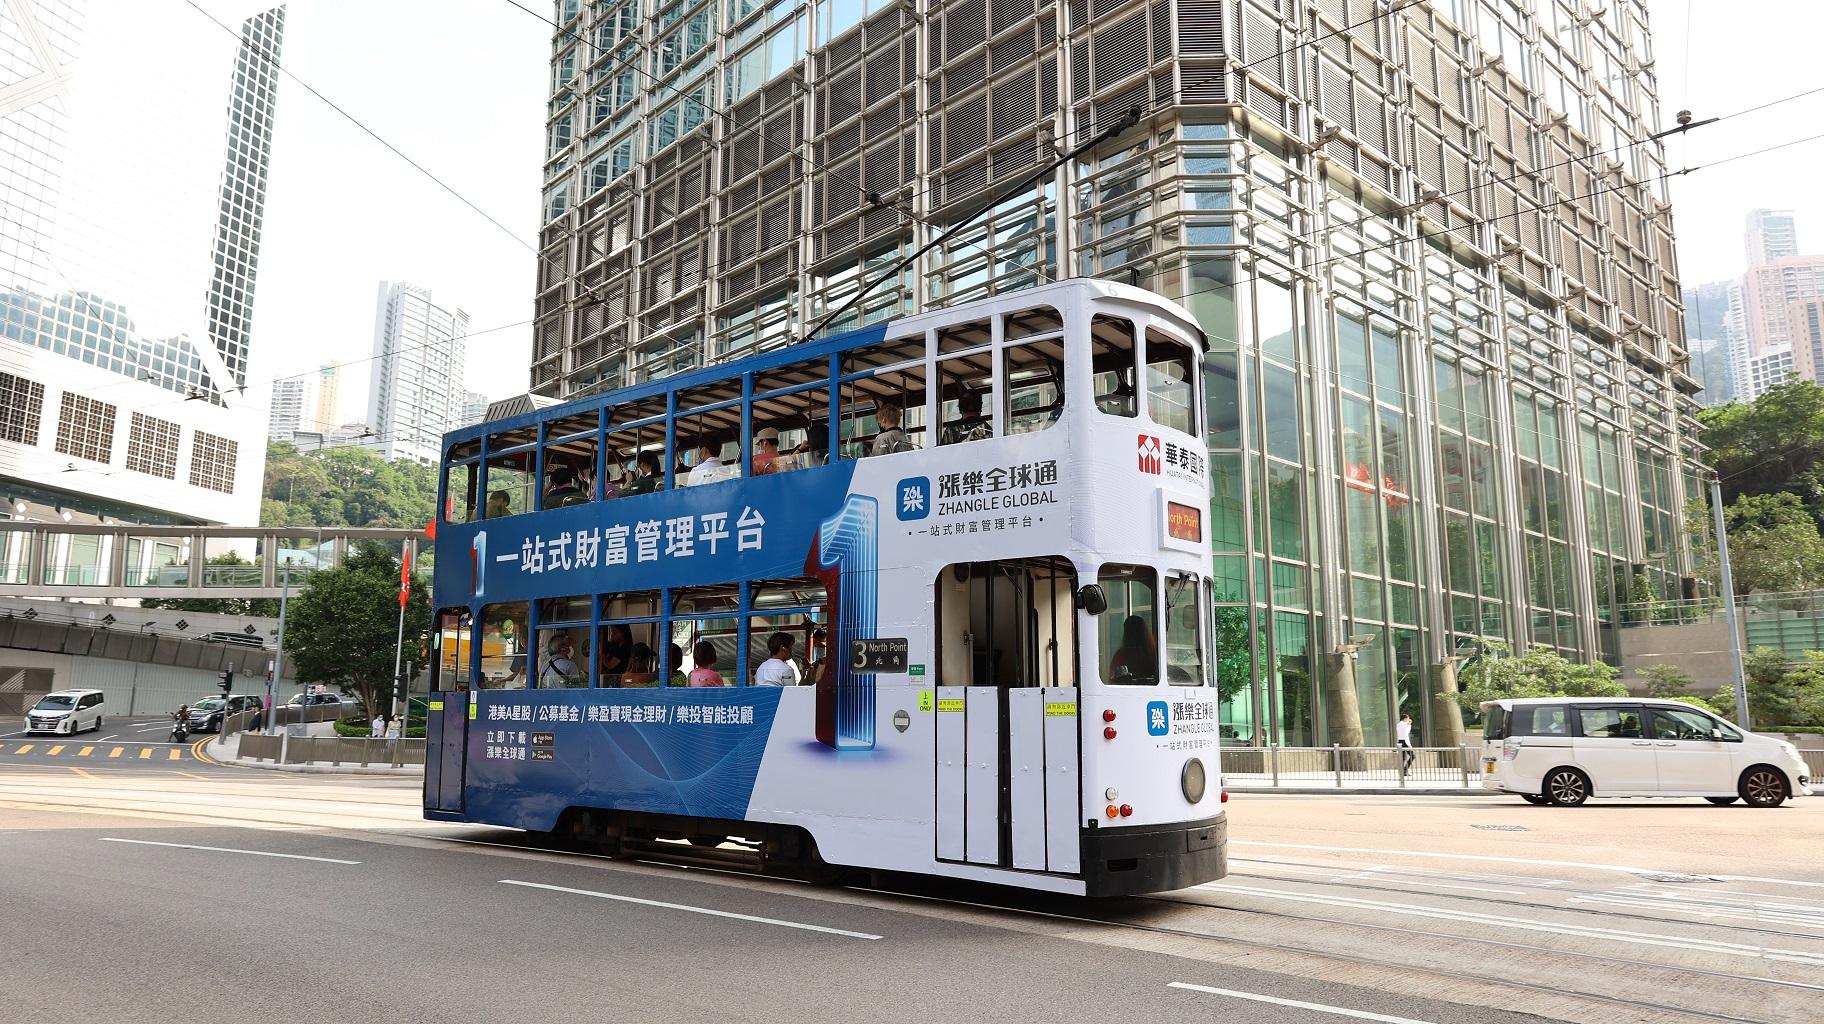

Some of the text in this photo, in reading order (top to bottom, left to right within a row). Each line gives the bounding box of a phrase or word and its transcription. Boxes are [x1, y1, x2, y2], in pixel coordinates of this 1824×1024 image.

[938, 460, 1058, 499] 漲樂全球通
[938, 490, 1058, 516] ZHANGLE GLOBAL
[918, 515, 1032, 537] 一站式財富管理平台
[495, 505, 767, 576] 一站式財富管理平台
[853, 640, 868, 668] 3
[869, 642, 907, 652] North Point
[876, 655, 900, 665] 北角
[488, 704, 531, 721] 港美A星股
[539, 704, 580, 722] 公募基金
[486, 730, 526, 744] 立即下載
[1173, 723, 1200, 734] ZHANGLE
